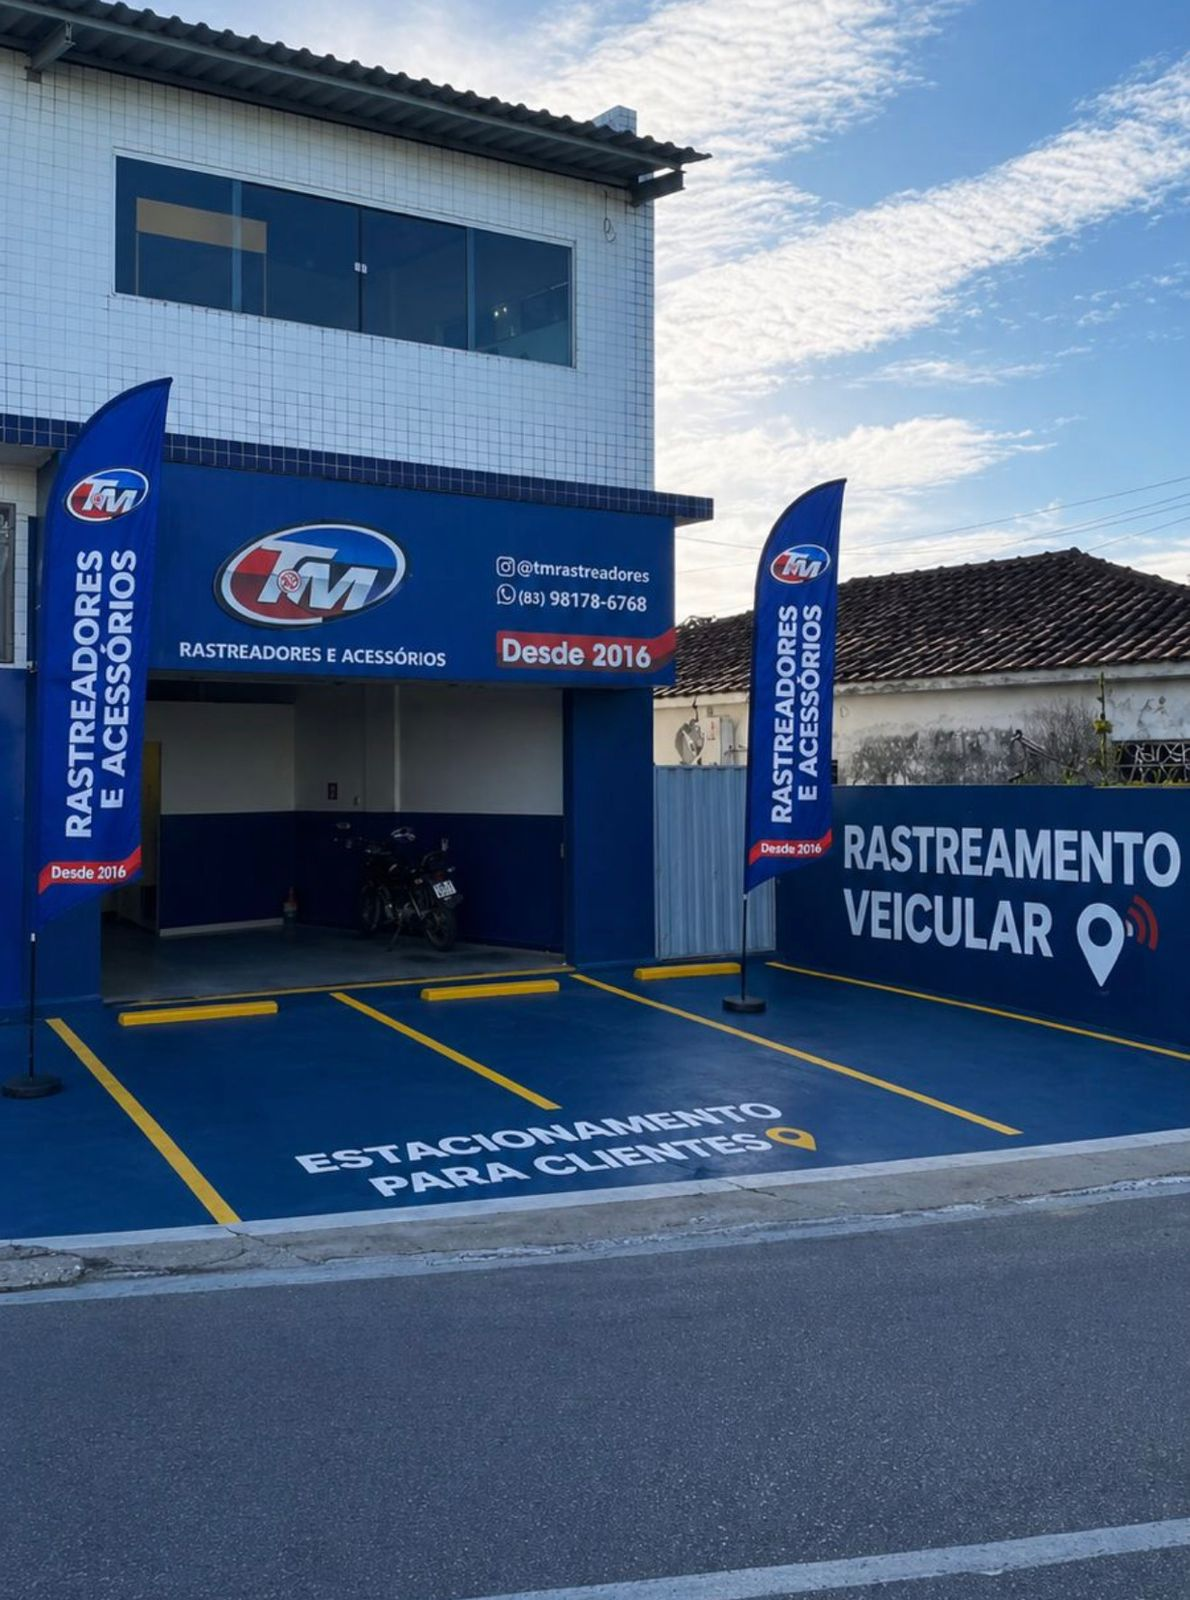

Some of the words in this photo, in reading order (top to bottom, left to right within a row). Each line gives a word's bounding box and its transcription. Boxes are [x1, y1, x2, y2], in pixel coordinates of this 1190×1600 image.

[82, 478, 137, 513] TM
[257, 539, 379, 611] TM
[517, 560, 650, 583] @tmrastreadores
[781, 551, 822, 578] TM
[518, 591, 546, 608] (83)
[549, 590, 648, 613] 98178-6768
[101, 549, 137, 778] ACESSÓRIOS
[179, 641, 322, 663] RASTREADORES
[326, 648, 336, 663] E
[341, 646, 447, 667] ACESSÓRIOS
[502, 637, 585, 666] Desde
[592, 643, 651, 669] 2016
[65, 550, 103, 838] RASTREADORES
[797, 604, 822, 778] ACESSÓRIOS
[771, 605, 798, 824] RASTREADORES
[100, 788, 124, 809] E
[798, 785, 818, 801] E
[761, 843, 796, 854] Desde
[797, 843, 822, 855] 2016
[844, 824, 1182, 888] RASTREAMENTO
[51, 865, 94, 879] Desde
[97, 864, 127, 880] 2016
[843, 888, 1053, 958] VEICULAR
[294, 1102, 782, 1175] ESTACIONAMENTO
[369, 1158, 530, 1198] PARA
[533, 1132, 774, 1176] CLIENTES
